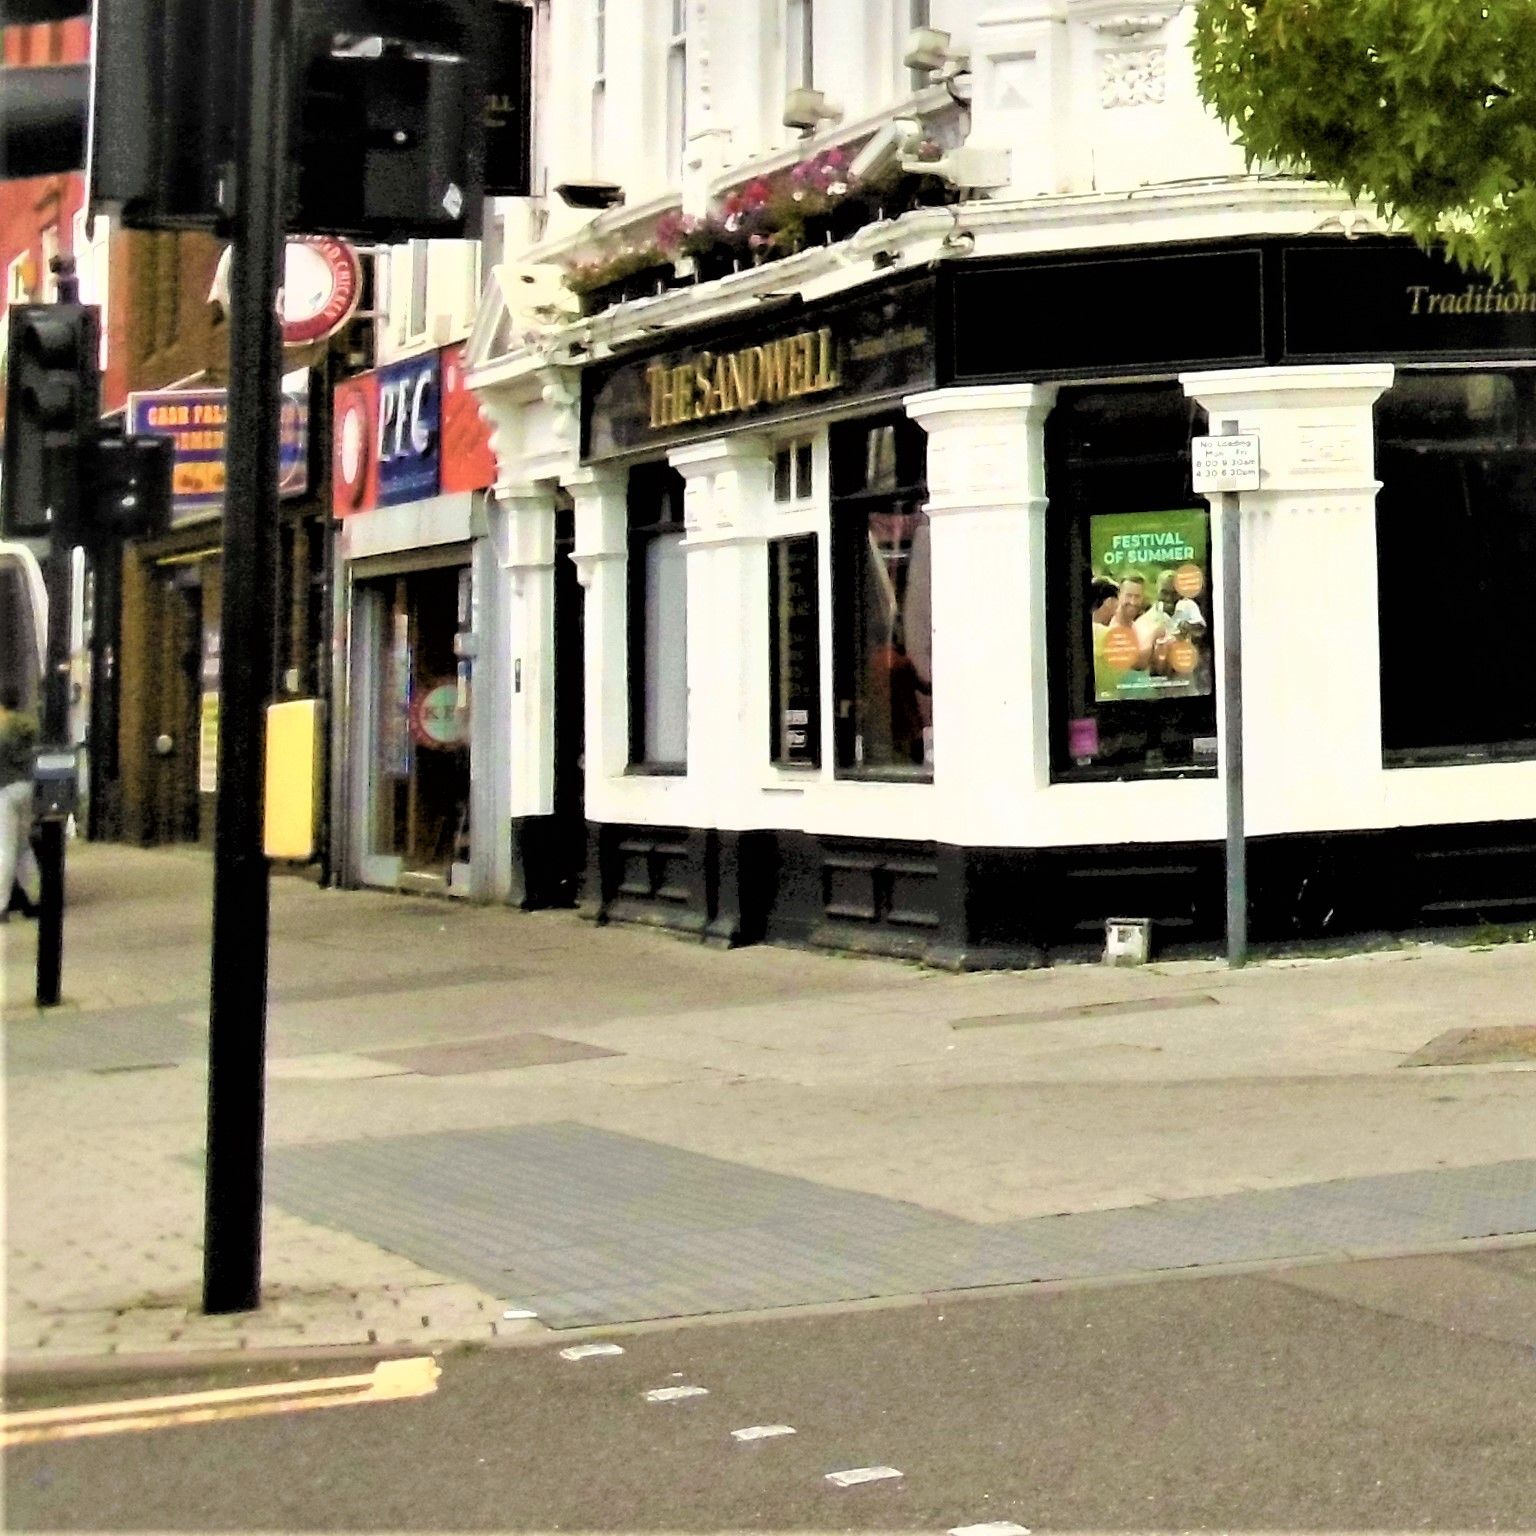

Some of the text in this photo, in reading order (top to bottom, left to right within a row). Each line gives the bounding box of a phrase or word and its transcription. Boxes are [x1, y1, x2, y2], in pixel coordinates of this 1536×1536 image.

[646, 363, 696, 429] THE
[695, 328, 842, 419] SANDWELL
[1113, 532, 1184, 549] FESTIVAL
[1104, 546, 1195, 564] OF SUMMER
